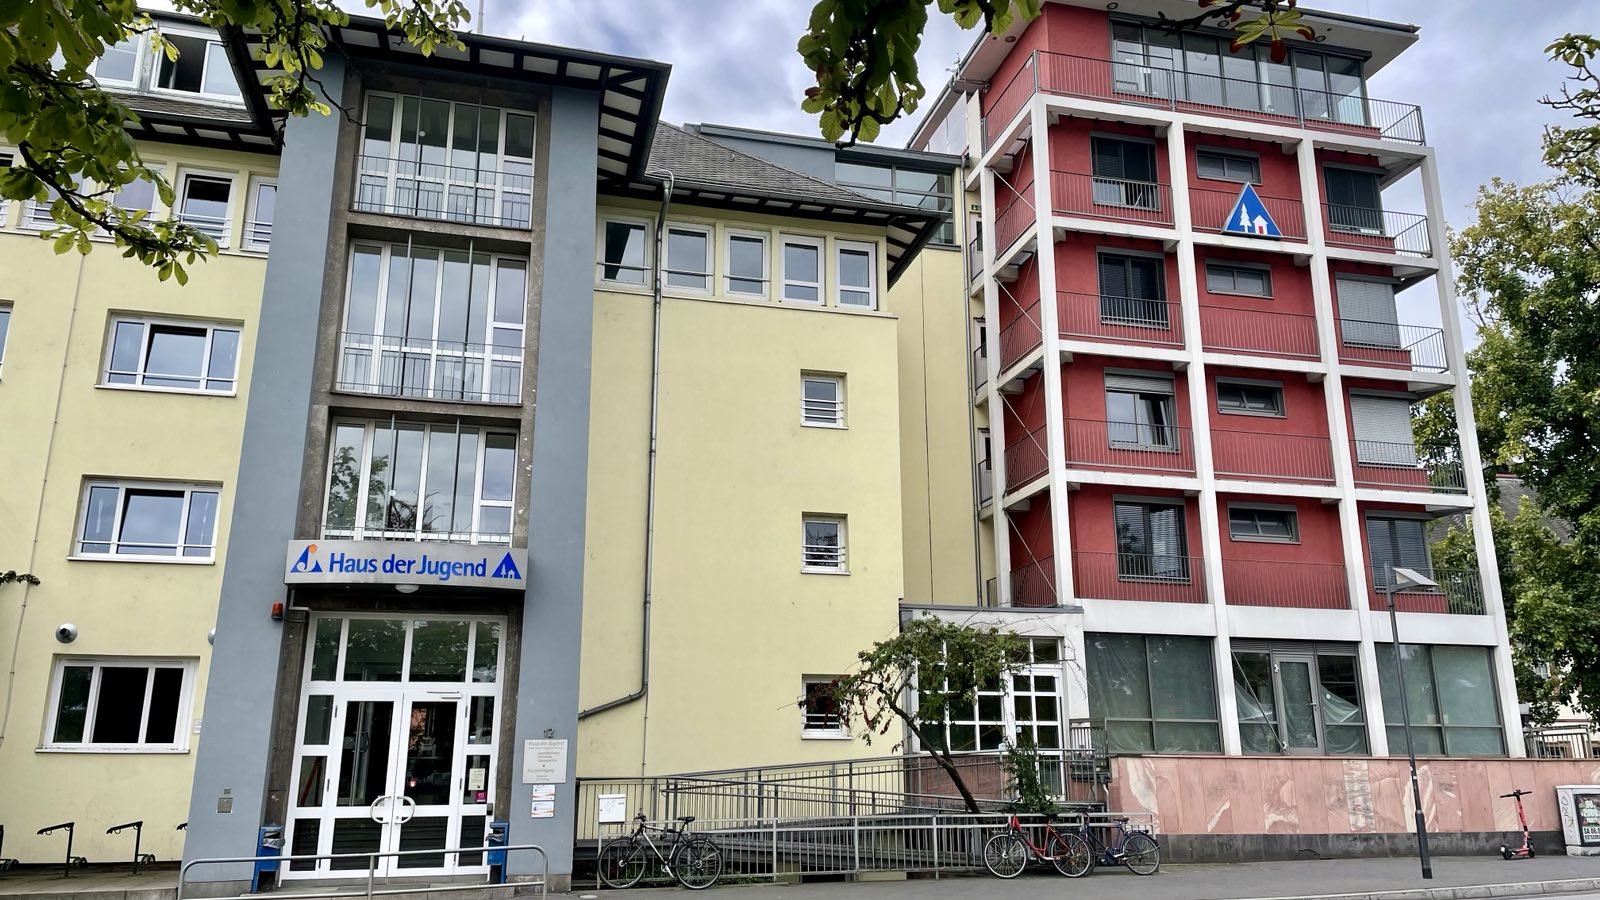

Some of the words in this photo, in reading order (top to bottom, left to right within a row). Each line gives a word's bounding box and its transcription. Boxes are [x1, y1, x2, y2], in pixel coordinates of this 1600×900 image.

[329, 552, 377, 573] Haus
[382, 553, 416, 574] der
[416, 554, 487, 581] Jugend
[543, 728, 554, 738] 12
